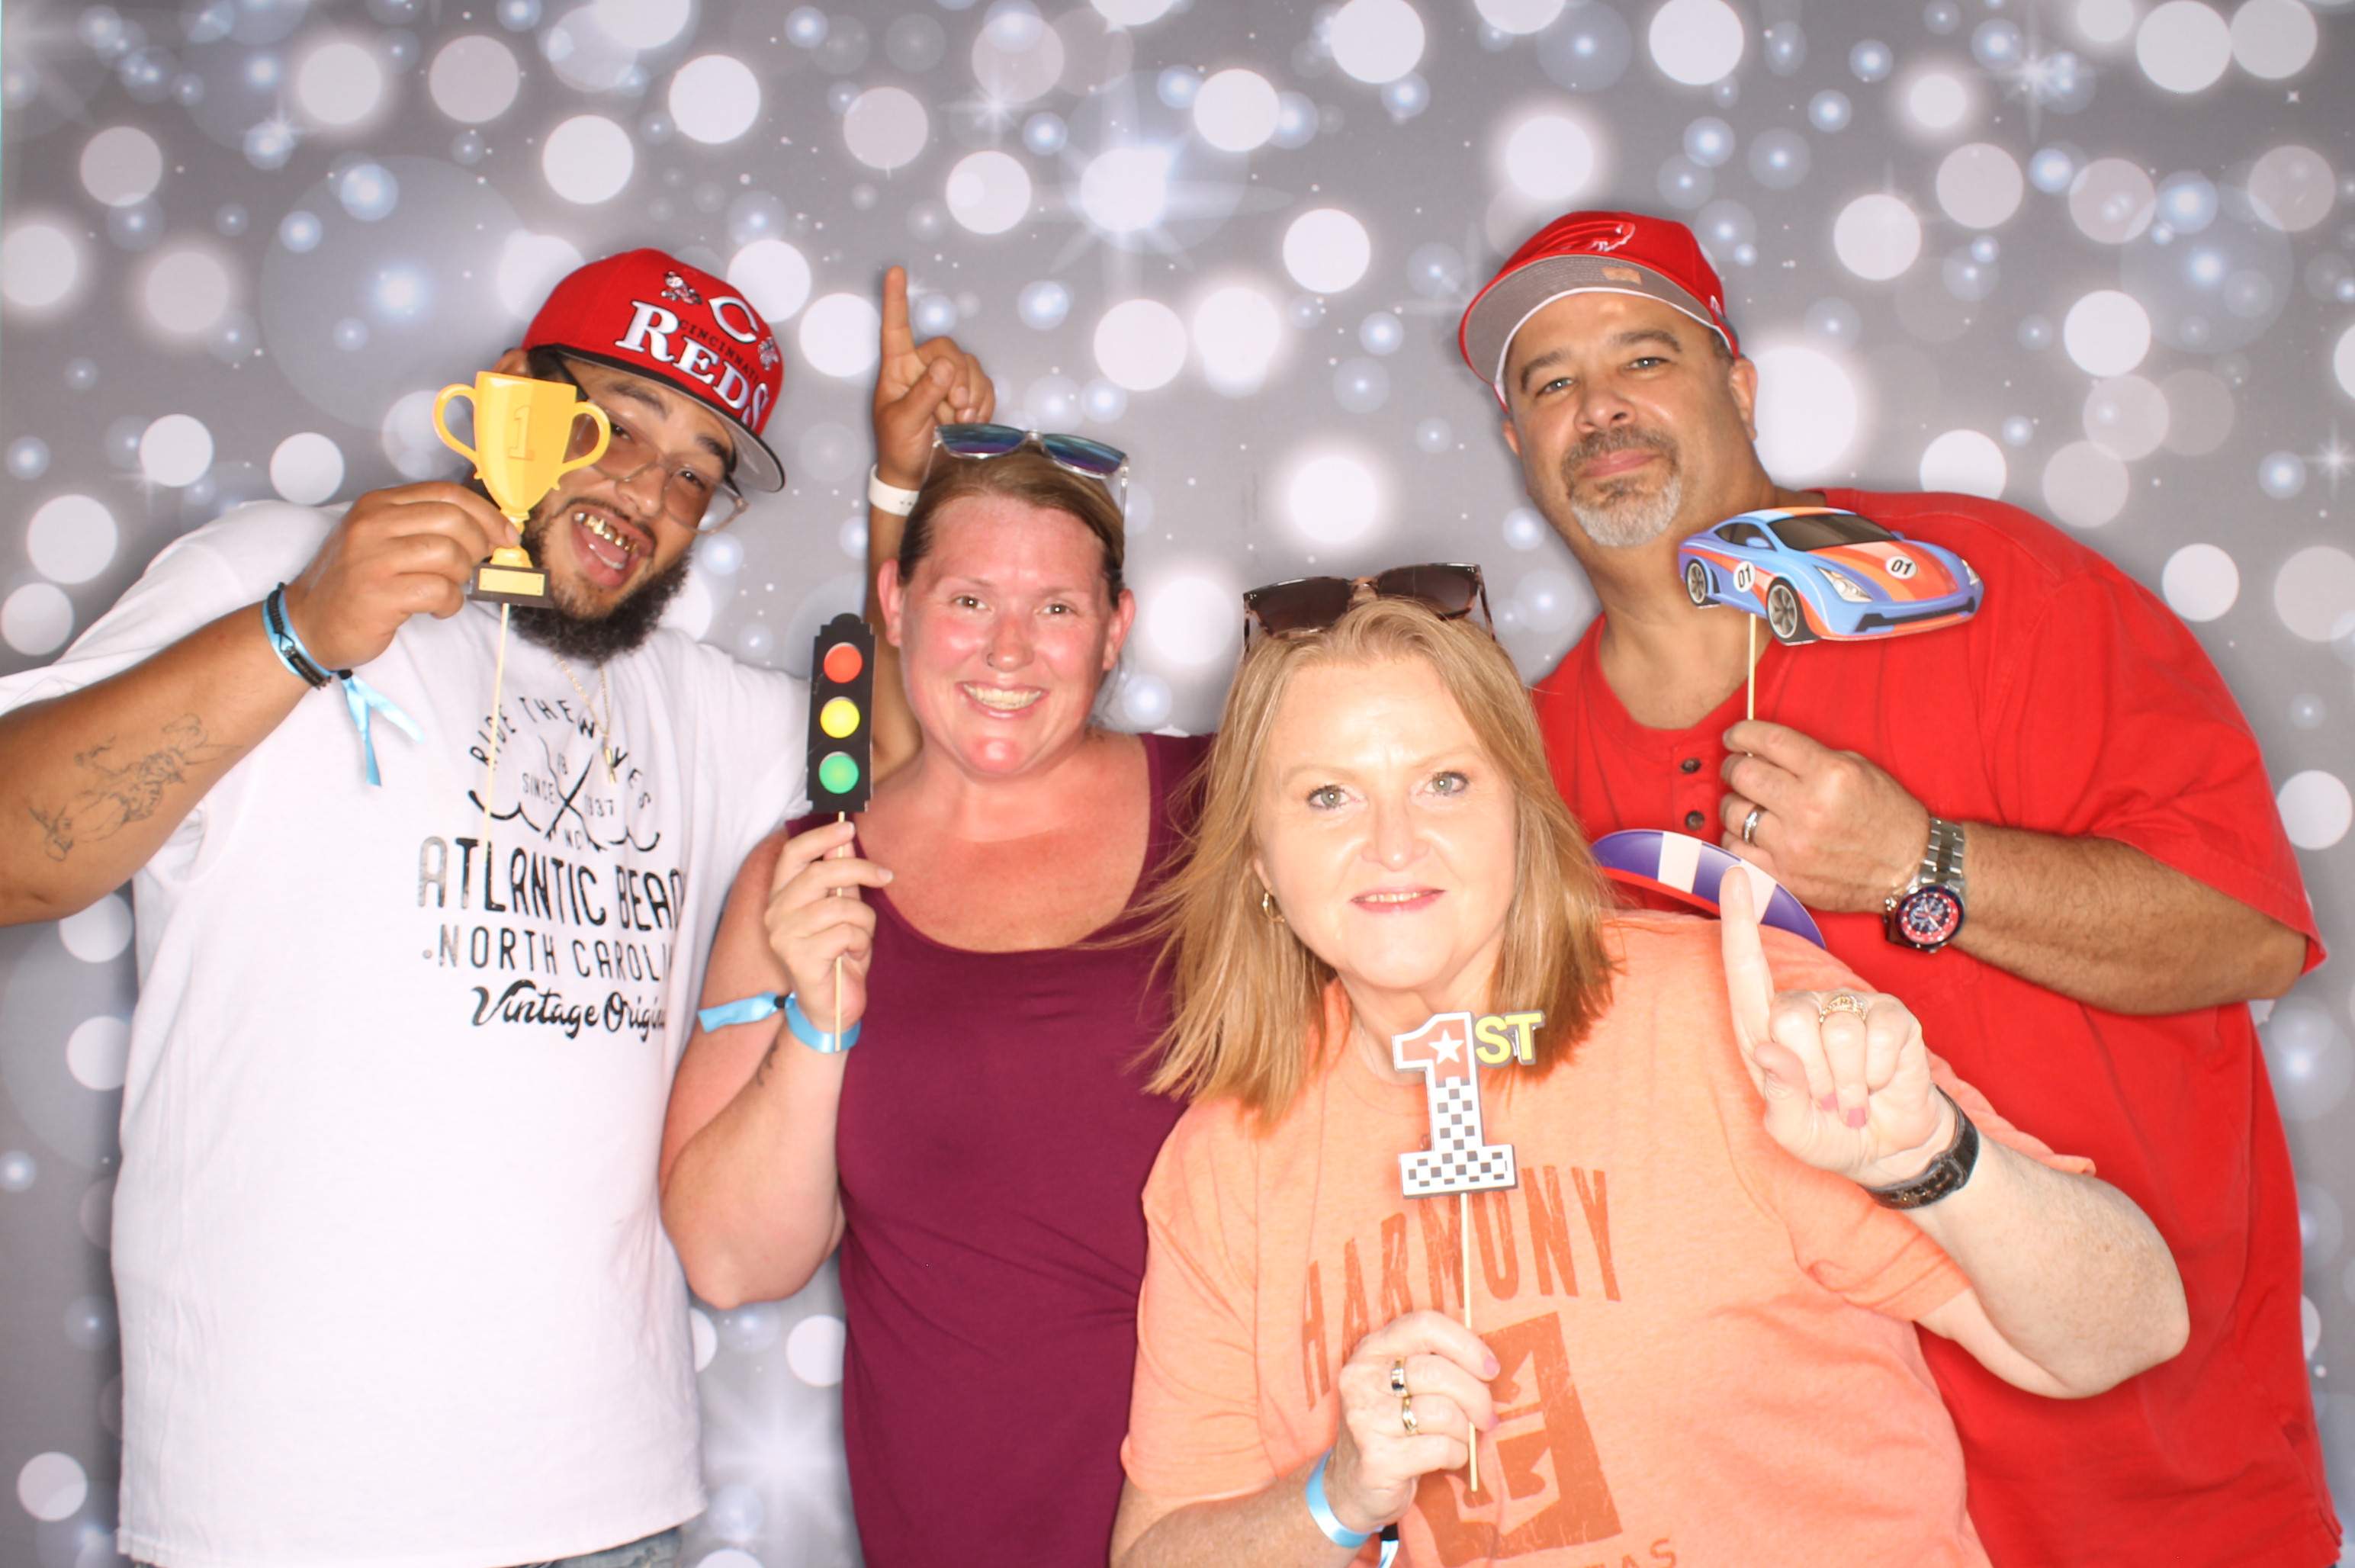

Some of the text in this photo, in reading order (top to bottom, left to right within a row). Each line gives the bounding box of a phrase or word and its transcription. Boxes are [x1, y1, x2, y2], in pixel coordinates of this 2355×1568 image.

[615, 300, 769, 431] REDS
[678, 319, 761, 384] CINCINNATI
[507, 404, 535, 461] 1
[1737, 563, 1753, 589] 01
[1890, 558, 1911, 574] 01
[519, 697, 573, 724] THE
[577, 718, 651, 810] WVES
[522, 772, 555, 805] SINCE
[418, 836, 686, 931] ATLANTIC BEAC
[439, 924, 672, 982] NORTH CAROLI
[471, 979, 666, 1043] Vintage Origin
[1392, 1011, 1543, 1196] 1ST
[1301, 1165, 1622, 1412] HARMONY
